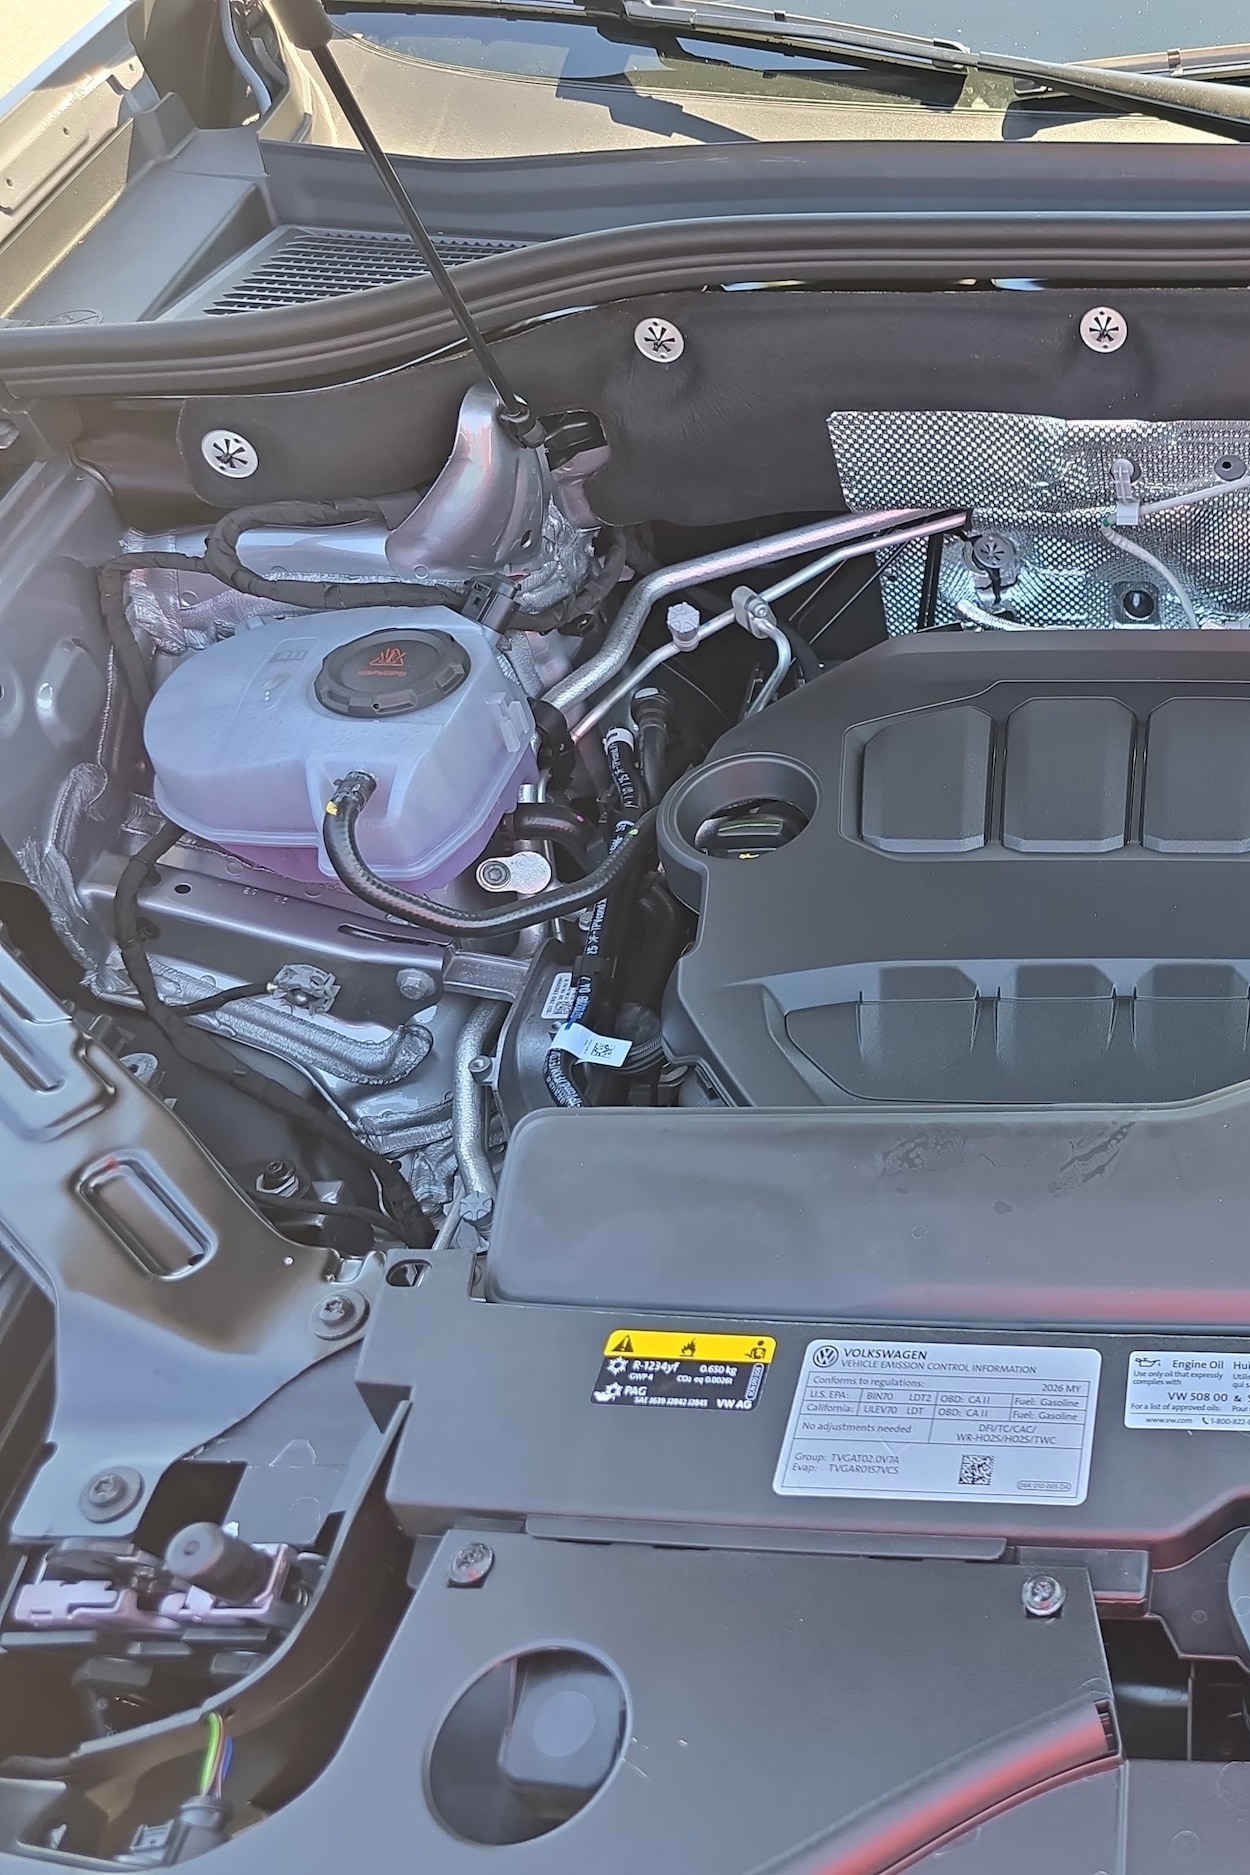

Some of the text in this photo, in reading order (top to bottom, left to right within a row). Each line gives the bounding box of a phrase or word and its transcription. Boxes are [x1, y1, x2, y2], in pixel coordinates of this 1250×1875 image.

[844, 1348, 928, 1360] VOLKSWAGEN
[633, 1360, 737, 1376] R-1234yf 0.650 kg
[842, 1360, 1037, 1374] VEHICLE EMISSION CONTROL INFORMATION
[1173, 1360, 1207, 1370] Engine
[1209, 1360, 1224, 1369] Oil
[1148, 1371, 1163, 1379] only
[1191, 1372, 1223, 1380] expressly
[814, 1376, 856, 1384] Conforms
[871, 1378, 925, 1389] regulations:
[1042, 1384, 1063, 1392] 2026
[1065, 1384, 1081, 1392] MY
[624, 1385, 647, 1395] PAG
[810, 1390, 826, 1398] U.S.
[829, 1391, 848, 1399] EPA:
[867, 1392, 893, 1401] BIN70
[909, 1393, 931, 1402] LDT2
[941, 1395, 964, 1403] OBD:
[968, 1396, 980, 1404] CA
[1015, 1397, 1036, 1406] Fuel:
[1041, 1399, 1079, 1408] Gasoline
[1168, 1392, 1187, 1401] VW
[1190, 1393, 1210, 1401] 508
[1213, 1393, 1228, 1401] 00
[634, 1396, 752, 1409] SAE VW AG
[1172, 1404, 1205, 1412] approved
[807, 1404, 854, 1413] California:
[864, 1405, 897, 1414] ULEV70
[907, 1406, 924, 1415] LDT
[938, 1408, 962, 1416] OBD:
[966, 1409, 978, 1417] CA
[1013, 1411, 1034, 1419] Fuel:
[1039, 1412, 1077, 1420] Gasoline
[803, 1422, 911, 1433] No adjustments needed
[795, 1452, 828, 1462] Group:
[792, 1463, 818, 1473] Evap:
